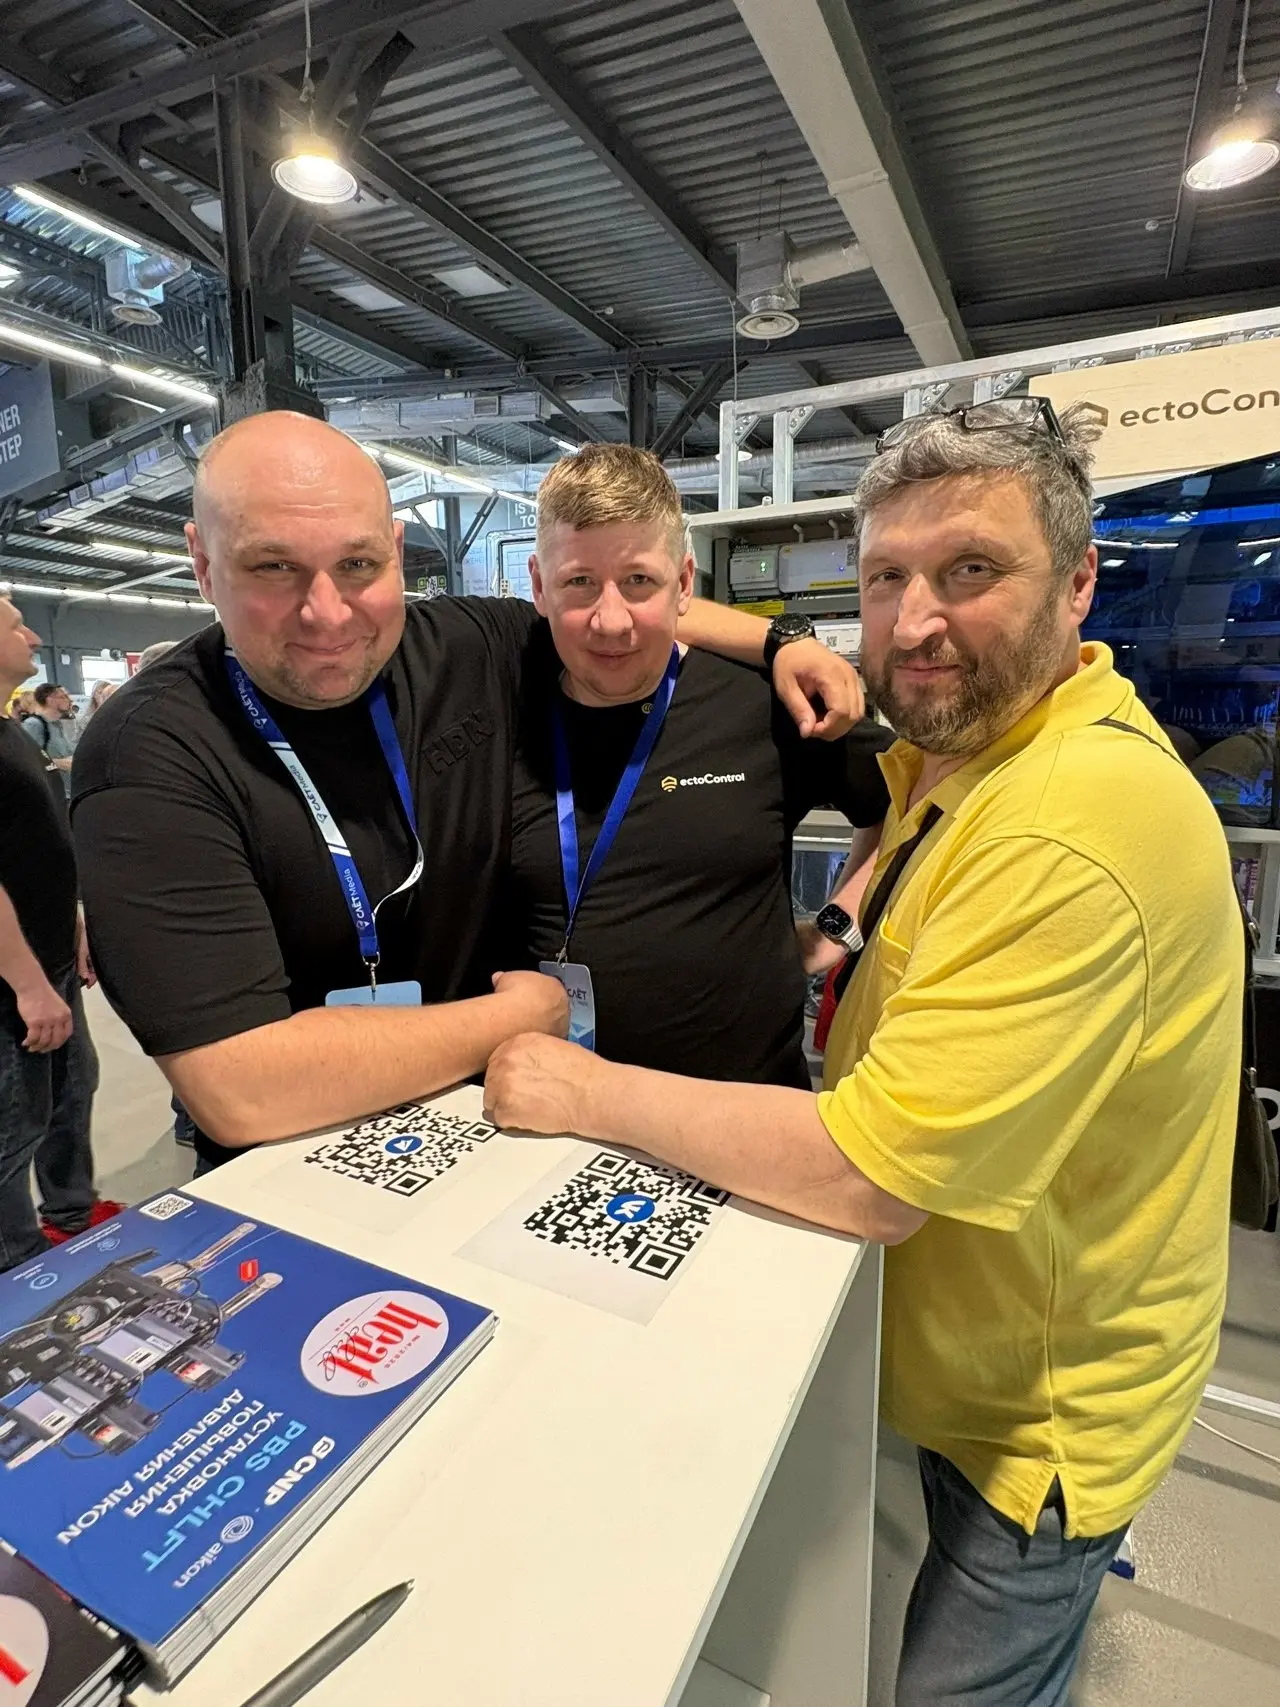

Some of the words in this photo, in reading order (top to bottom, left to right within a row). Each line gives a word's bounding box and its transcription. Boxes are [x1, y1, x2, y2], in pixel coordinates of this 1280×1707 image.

[1120, 388, 1280, 427] ectoCon
[680, 772, 745, 787] ectoControl
[323, 1301, 442, 1385] heat
[123, 1400, 265, 1518] ПОВЫШЕНИЯ
[133, 1388, 244, 1483] ДАВЛЕНИЯ
[156, 1410, 284, 1516] УСТАНОВКА
[244, 1419, 307, 1472] PBS
[56, 1480, 134, 1545] AIKON
[141, 1474, 246, 1573] CHLFT
[172, 1542, 223, 1589] aikon
